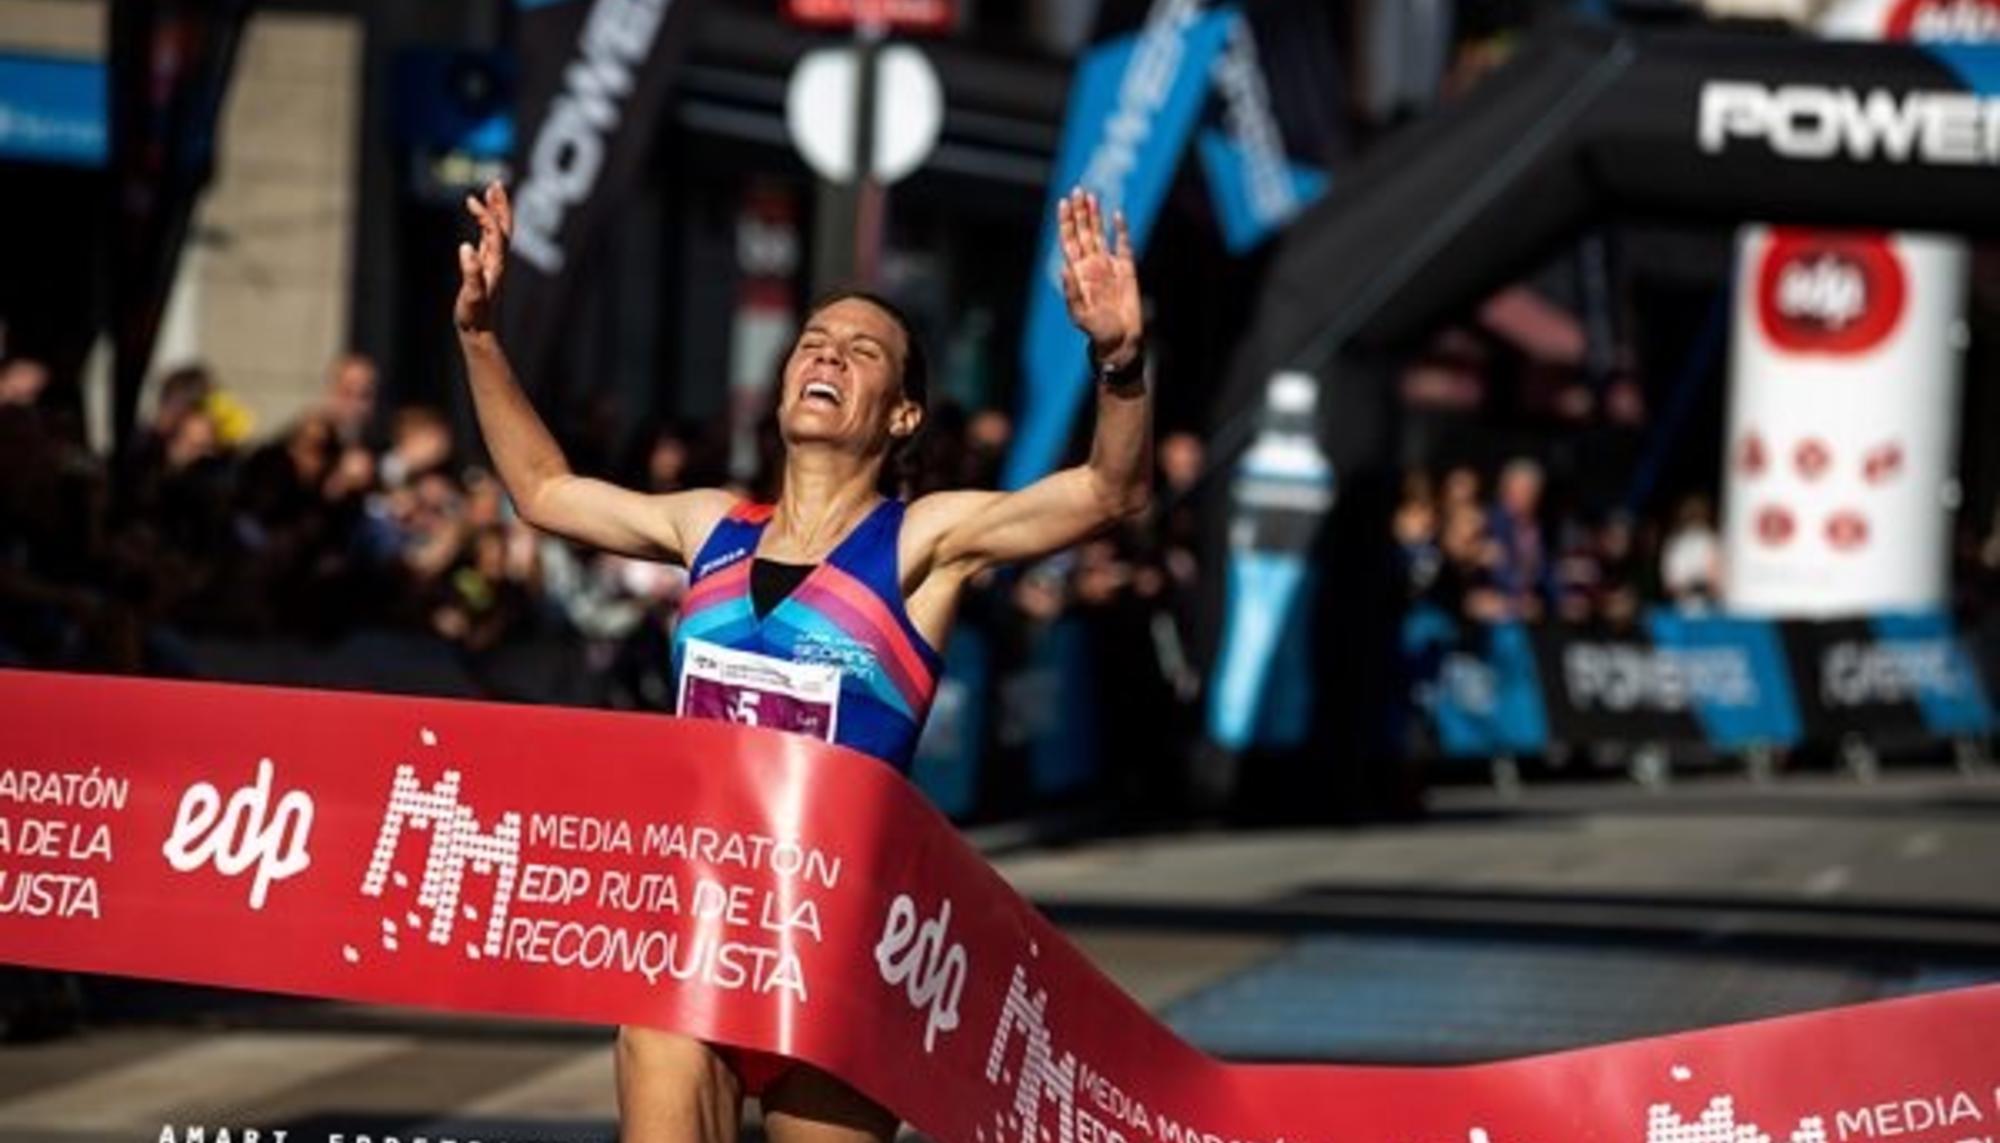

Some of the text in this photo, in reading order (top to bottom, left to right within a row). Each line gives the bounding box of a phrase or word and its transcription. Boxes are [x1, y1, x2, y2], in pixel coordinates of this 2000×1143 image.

[1699, 80, 2000, 167] POWE
[17, 819, 67, 857] DE
[69, 823, 113, 862] LA
[163, 758, 315, 910] edp
[529, 812, 632, 855] MEDIA
[518, 863, 823, 943] EDP RUTA DE LA
[503, 917, 807, 1002] RECONQUISTA
[875, 893, 968, 1053] edp
[1079, 1063, 1154, 1136] MEDIA
[1836, 1091, 1983, 1141] MEDIA
